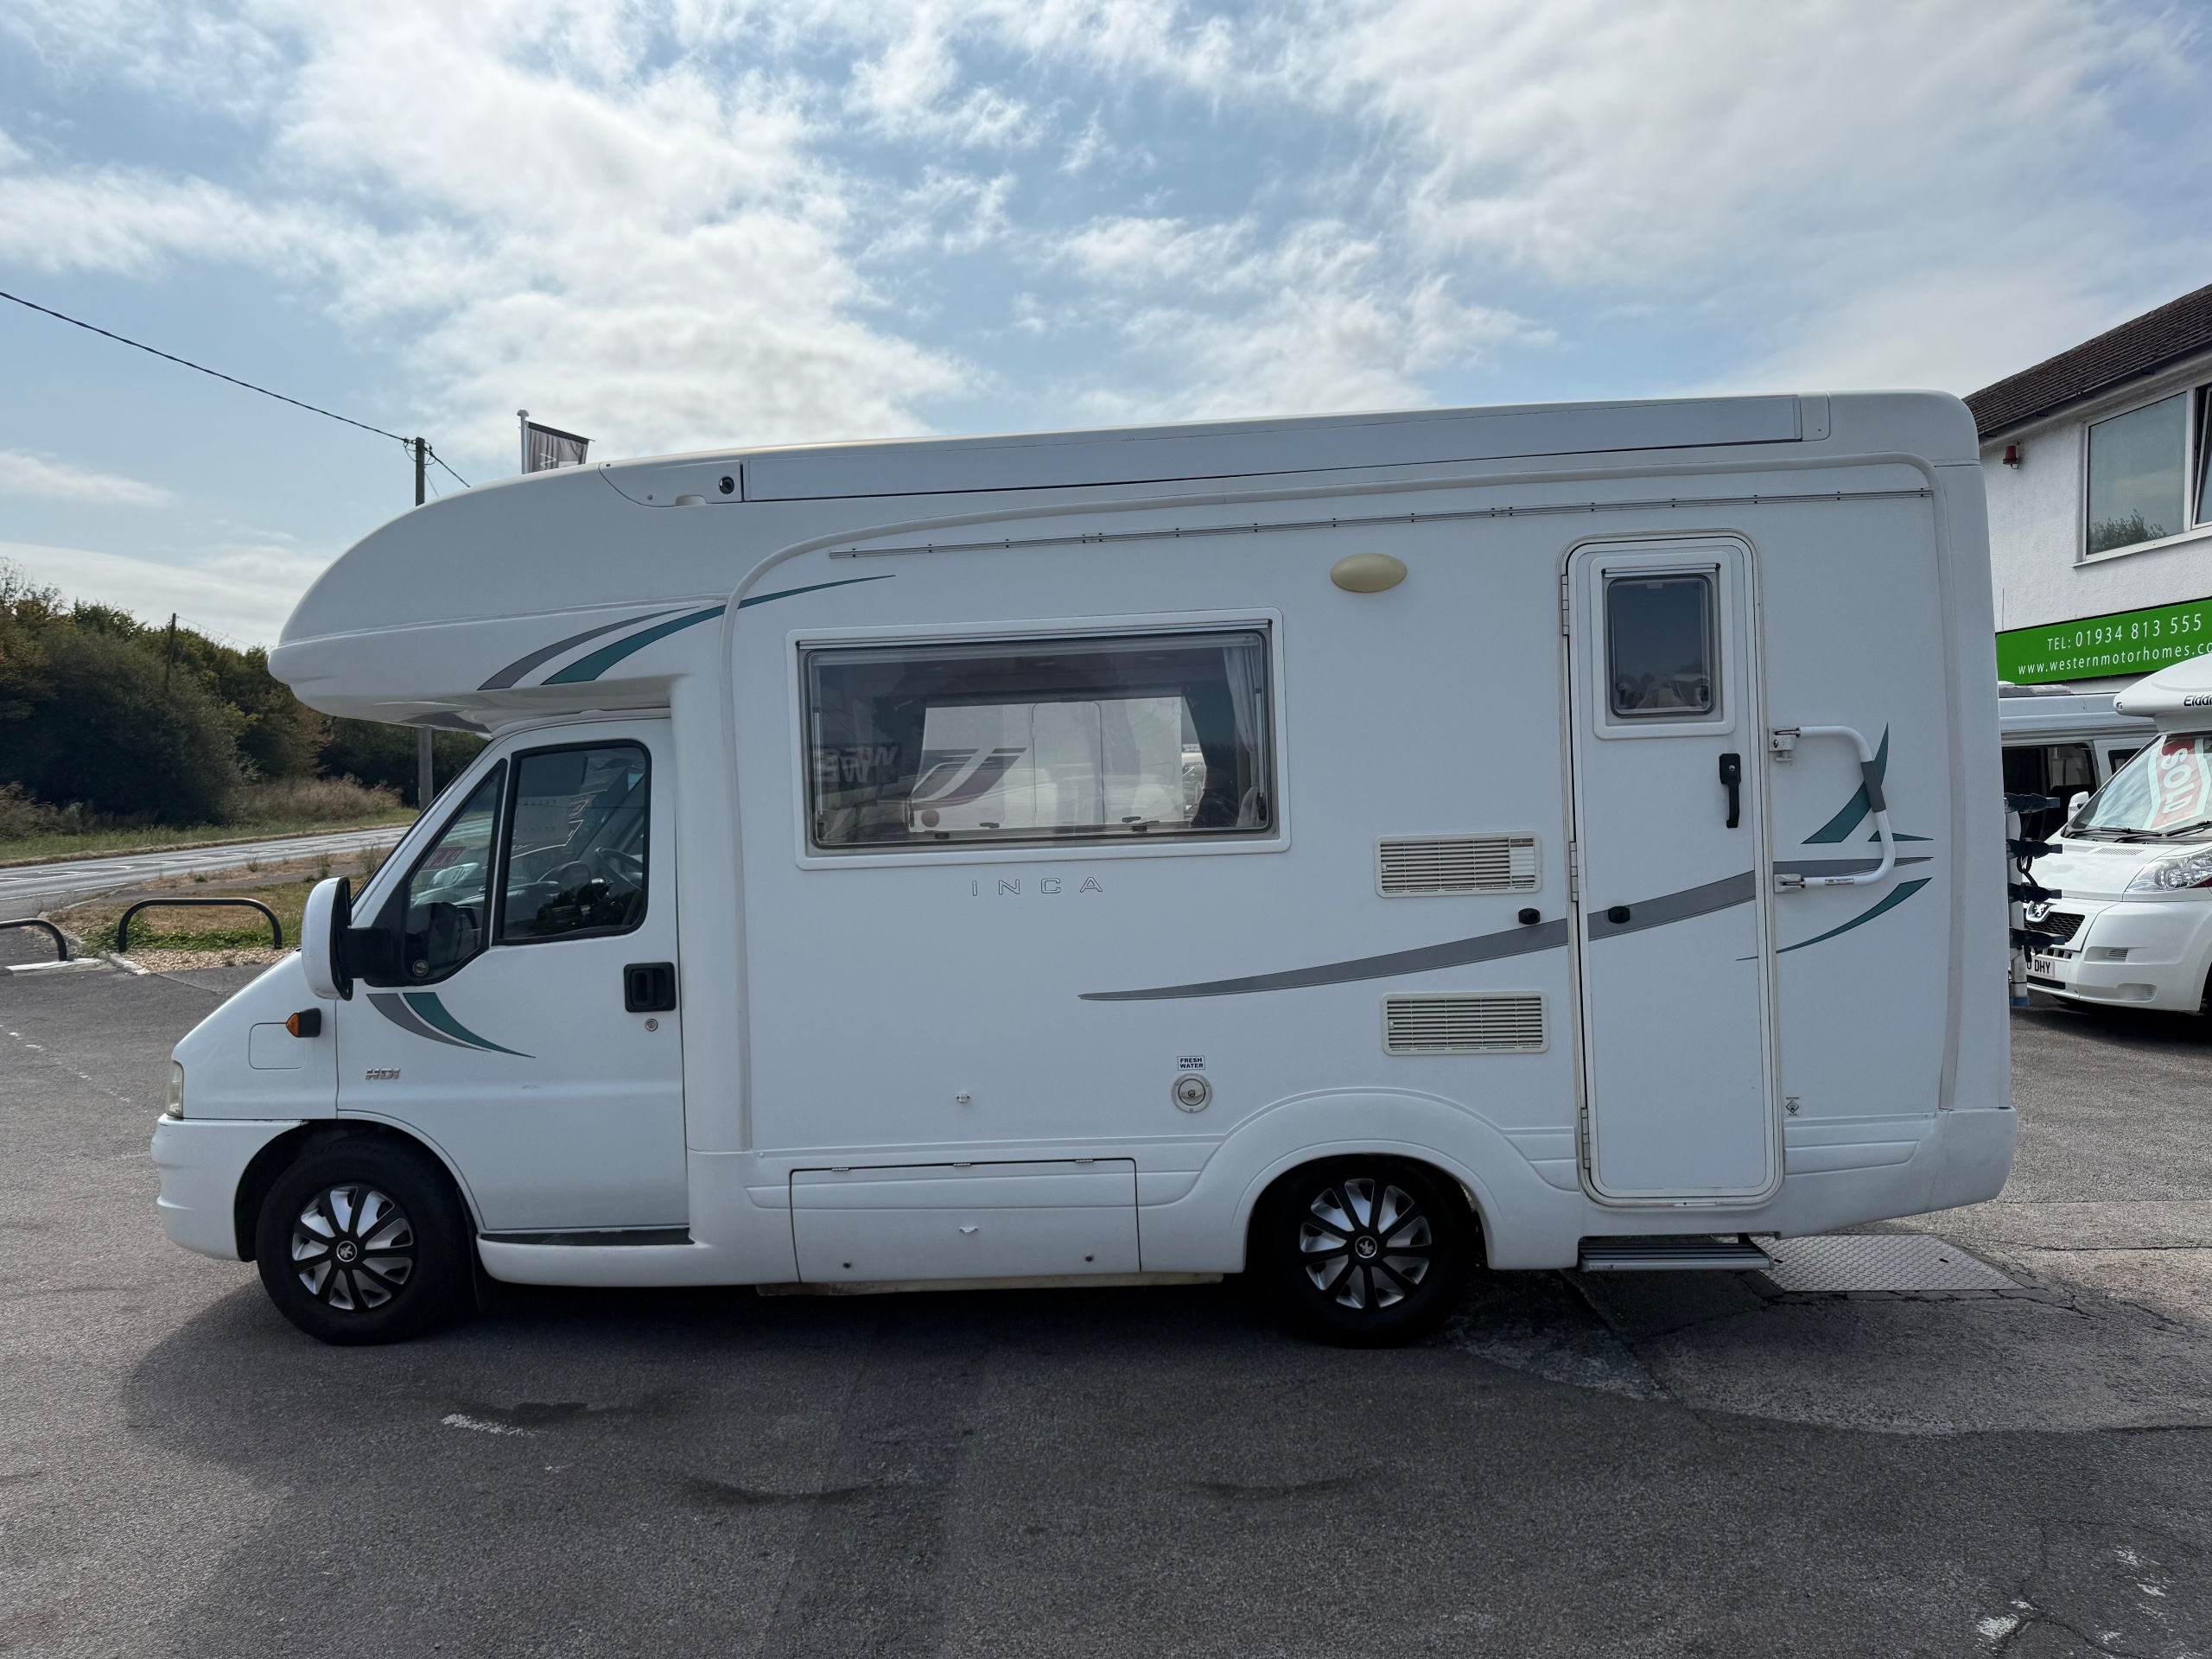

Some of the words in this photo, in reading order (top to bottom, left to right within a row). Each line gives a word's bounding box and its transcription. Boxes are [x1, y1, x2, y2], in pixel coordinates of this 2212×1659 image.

[2047, 637, 2071, 651] TEL:
[2075, 626, 2122, 647] 01934
[2131, 620, 2160, 639] 813
[2171, 613, 2202, 634] 555
[2160, 747, 2193, 814] SOLD
[972, 876, 1103, 896] INCA
[365, 1068, 400, 1080] HDI
